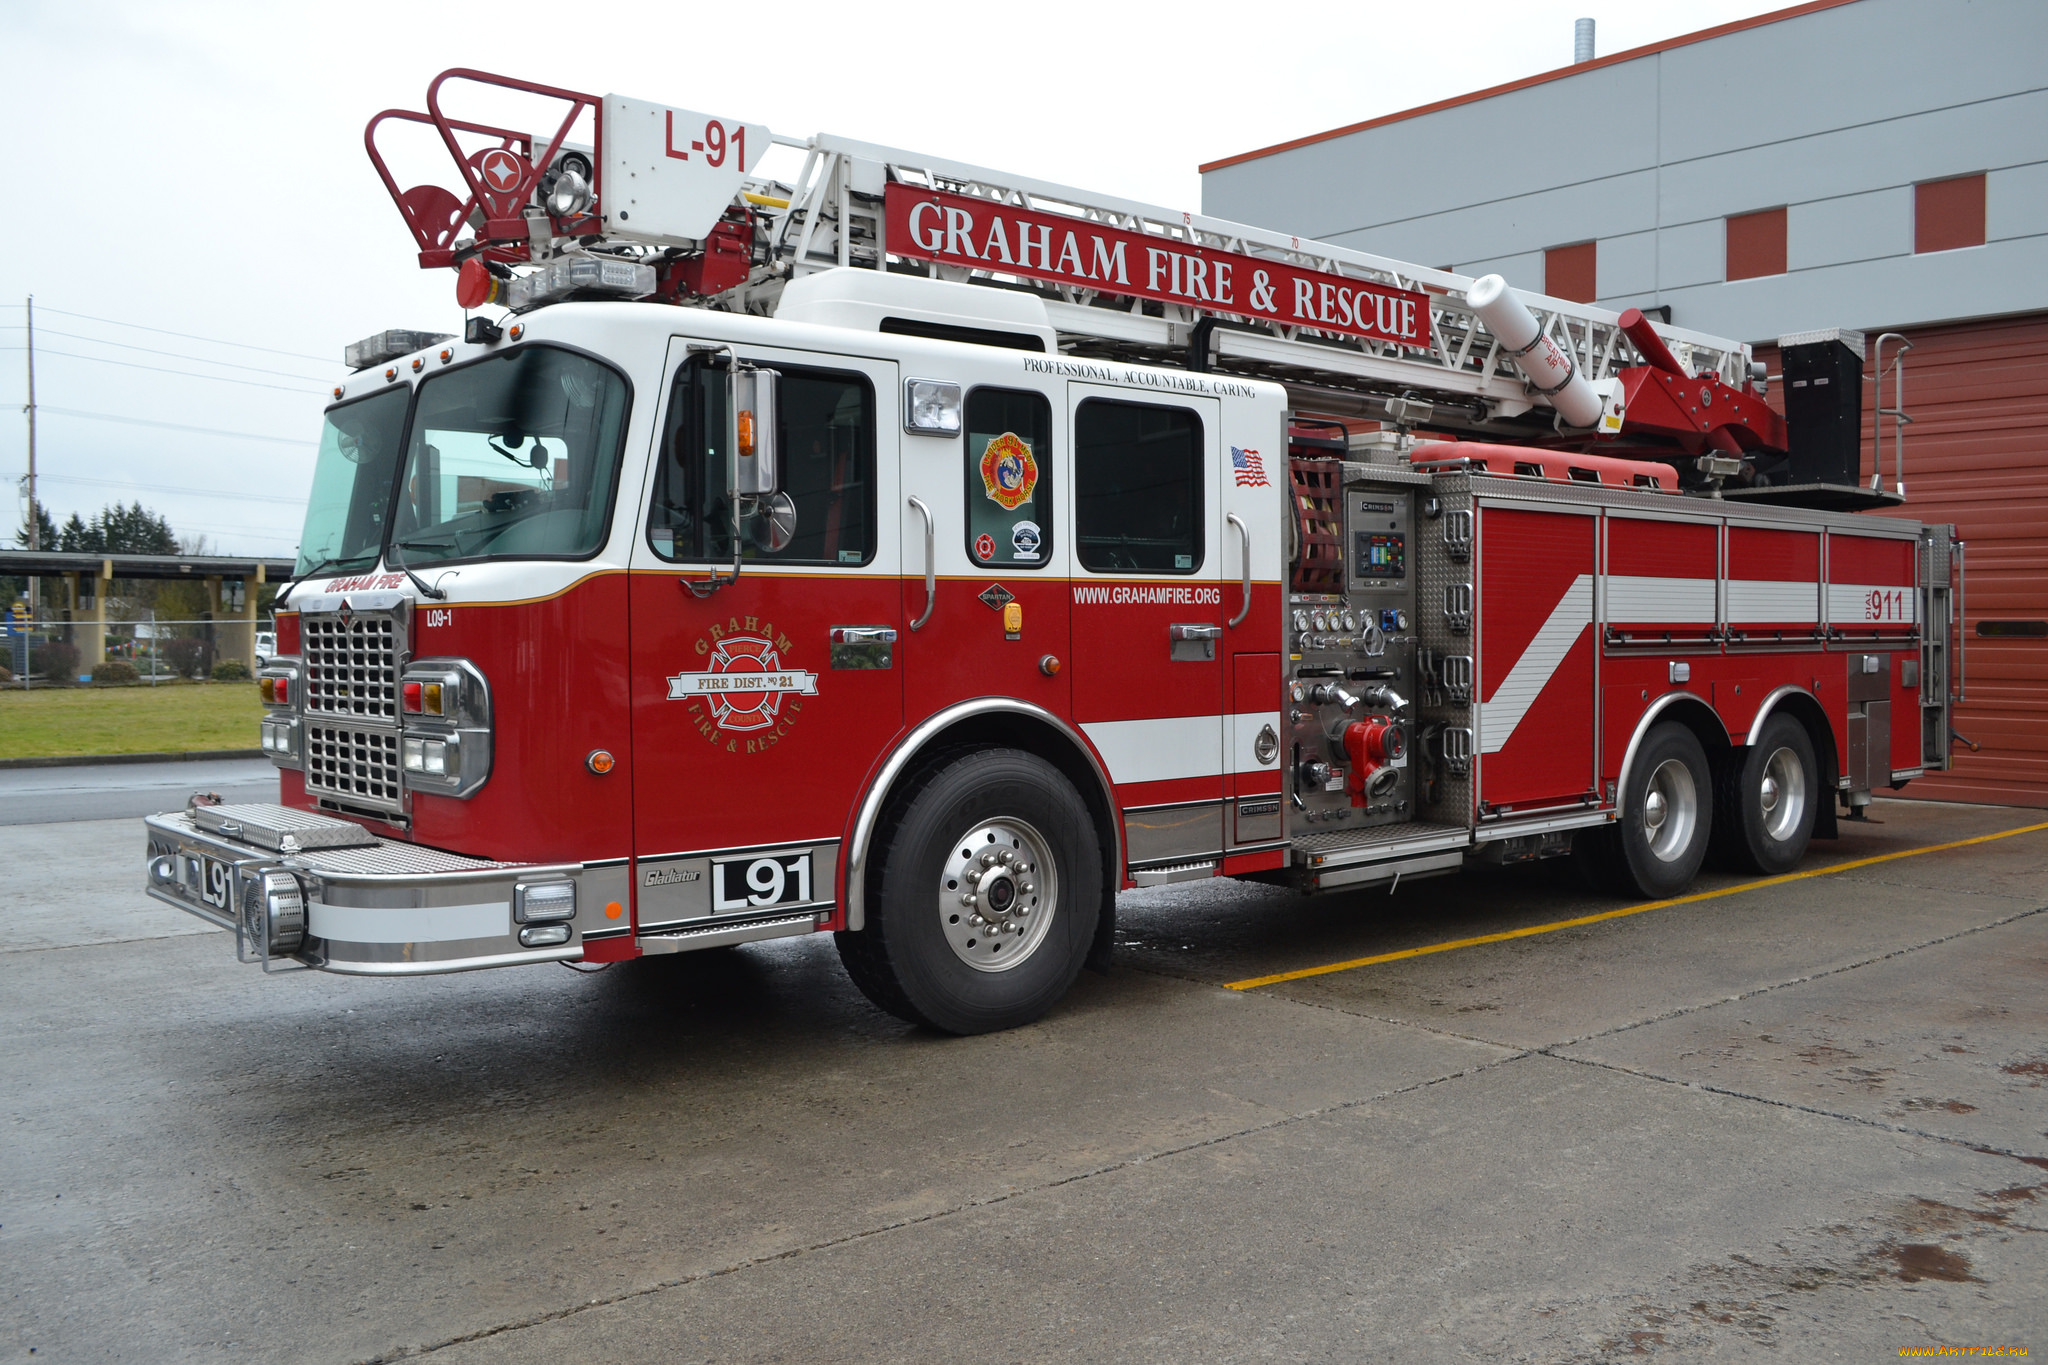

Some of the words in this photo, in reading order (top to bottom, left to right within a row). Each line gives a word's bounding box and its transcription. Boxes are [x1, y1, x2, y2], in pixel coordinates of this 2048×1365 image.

[666, 109, 744, 172] L-91
[1183, 212, 1191, 225] 75
[1291, 236, 1299, 249] 70
[908, 201, 1131, 286] GRAHAM
[1146, 247, 1233, 305] FIRE
[1249, 269, 1278, 313] &
[1292, 277, 1417, 338] RESCUE
[1541, 334, 1571, 374] BREATHING
[1545, 354, 1558, 370] AIR
[1023, 357, 1118, 383] PROFESSIONAL,
[1123, 370, 1209, 395] ACCOUNTABLE,
[1213, 381, 1256, 399] CARING
[984, 438, 1005, 465] LADDER
[1007, 435, 1018, 447] 91
[984, 473, 995, 492] THE
[994, 491, 1014, 505] WORK
[1016, 479, 1034, 503] HORSE
[325, 575, 377, 593] GRAHAM
[374, 574, 406, 590] FIRE
[1073, 587, 1220, 604] WWW.GRAHAMFIRE.ORG
[427, 609, 452, 627] L09-1
[1872, 590, 1902, 620] 911
[694, 615, 793, 655] GRAHAM
[729, 644, 760, 653] PIERCE
[697, 678, 729, 690] FIRE
[734, 677, 767, 689] DIST.
[779, 676, 793, 687] 21
[688, 703, 722, 746] FIRE
[726, 738, 738, 753] &
[746, 699, 803, 754] RESCUE
[729, 713, 763, 723] COUNTY
[202, 856, 235, 913] L91
[644, 868, 701, 887] Gladiator
[713, 855, 810, 911] L91
